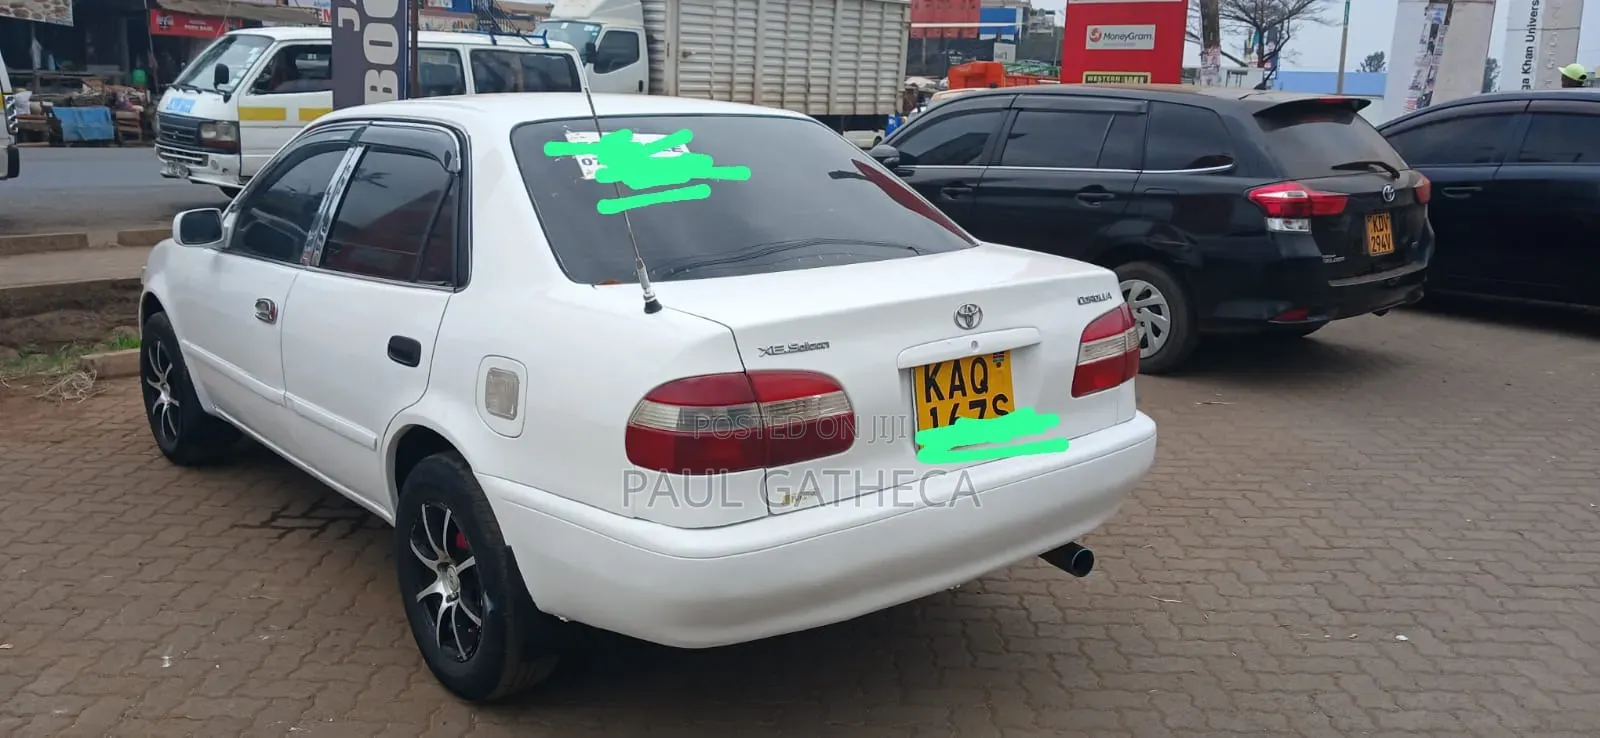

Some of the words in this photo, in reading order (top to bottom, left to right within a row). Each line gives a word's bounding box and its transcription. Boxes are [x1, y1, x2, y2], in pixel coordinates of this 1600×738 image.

[1103, 32, 1153, 41] MoneyGram
[1521, 46, 1534, 74] Khan
[1373, 215, 1389, 233] KDV
[1371, 234, 1391, 252] 294V
[924, 356, 988, 402] KAQ
